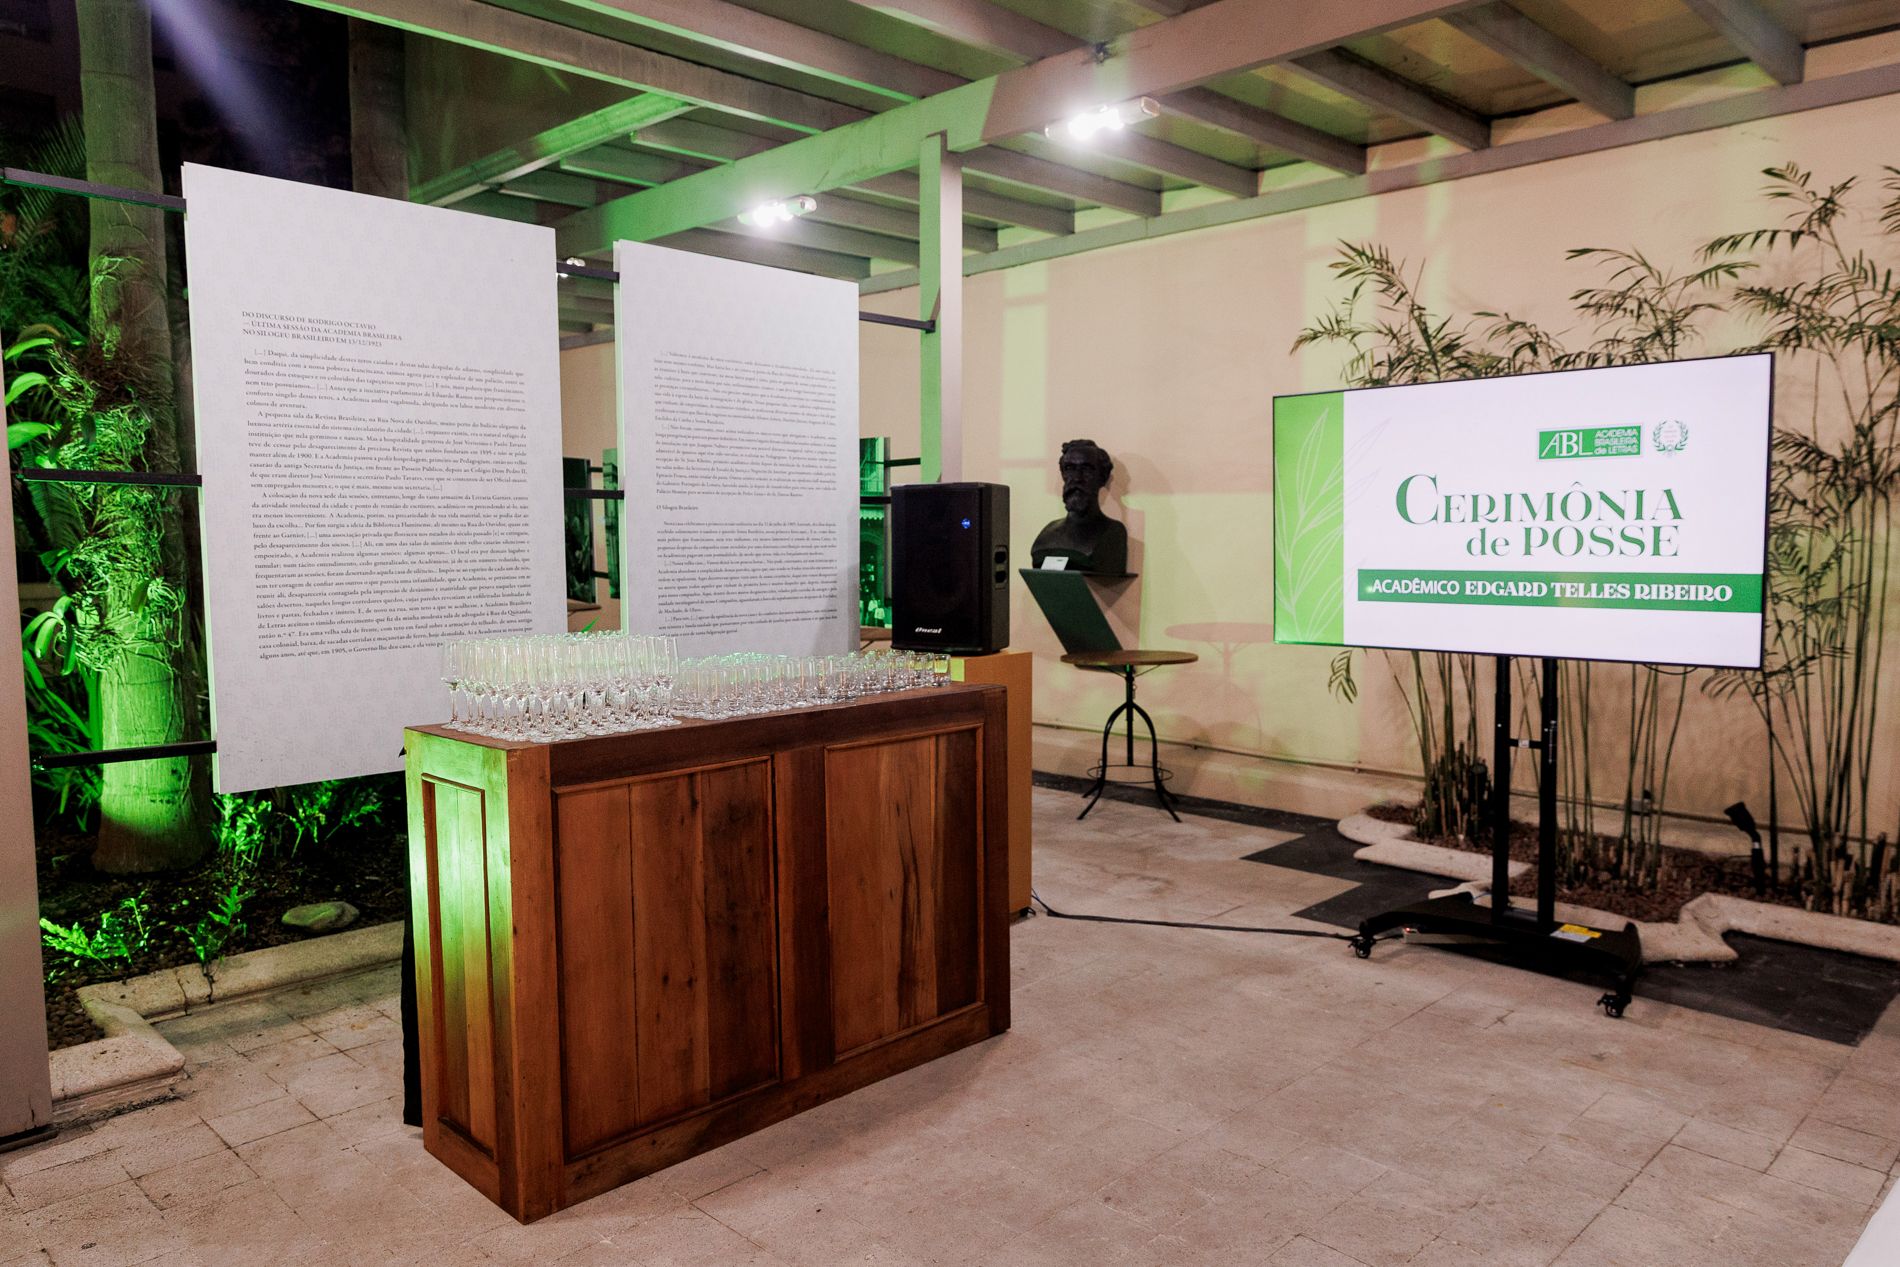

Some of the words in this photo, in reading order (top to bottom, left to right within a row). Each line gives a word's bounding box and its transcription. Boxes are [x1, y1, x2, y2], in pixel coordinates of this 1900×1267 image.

[1541, 432, 1594, 456] ABL
[1595, 428, 1638, 438] ACADEMIA
[1608, 445, 1638, 454] LETRAS
[1466, 528, 1510, 557] de
[1523, 524, 1680, 557] POSSE
[1372, 578, 1460, 595] ACADÊMICO
[1465, 580, 1548, 597] EDGARD
[1551, 582, 1631, 600] TELLES
[1634, 584, 1733, 602] RIBEIRO
